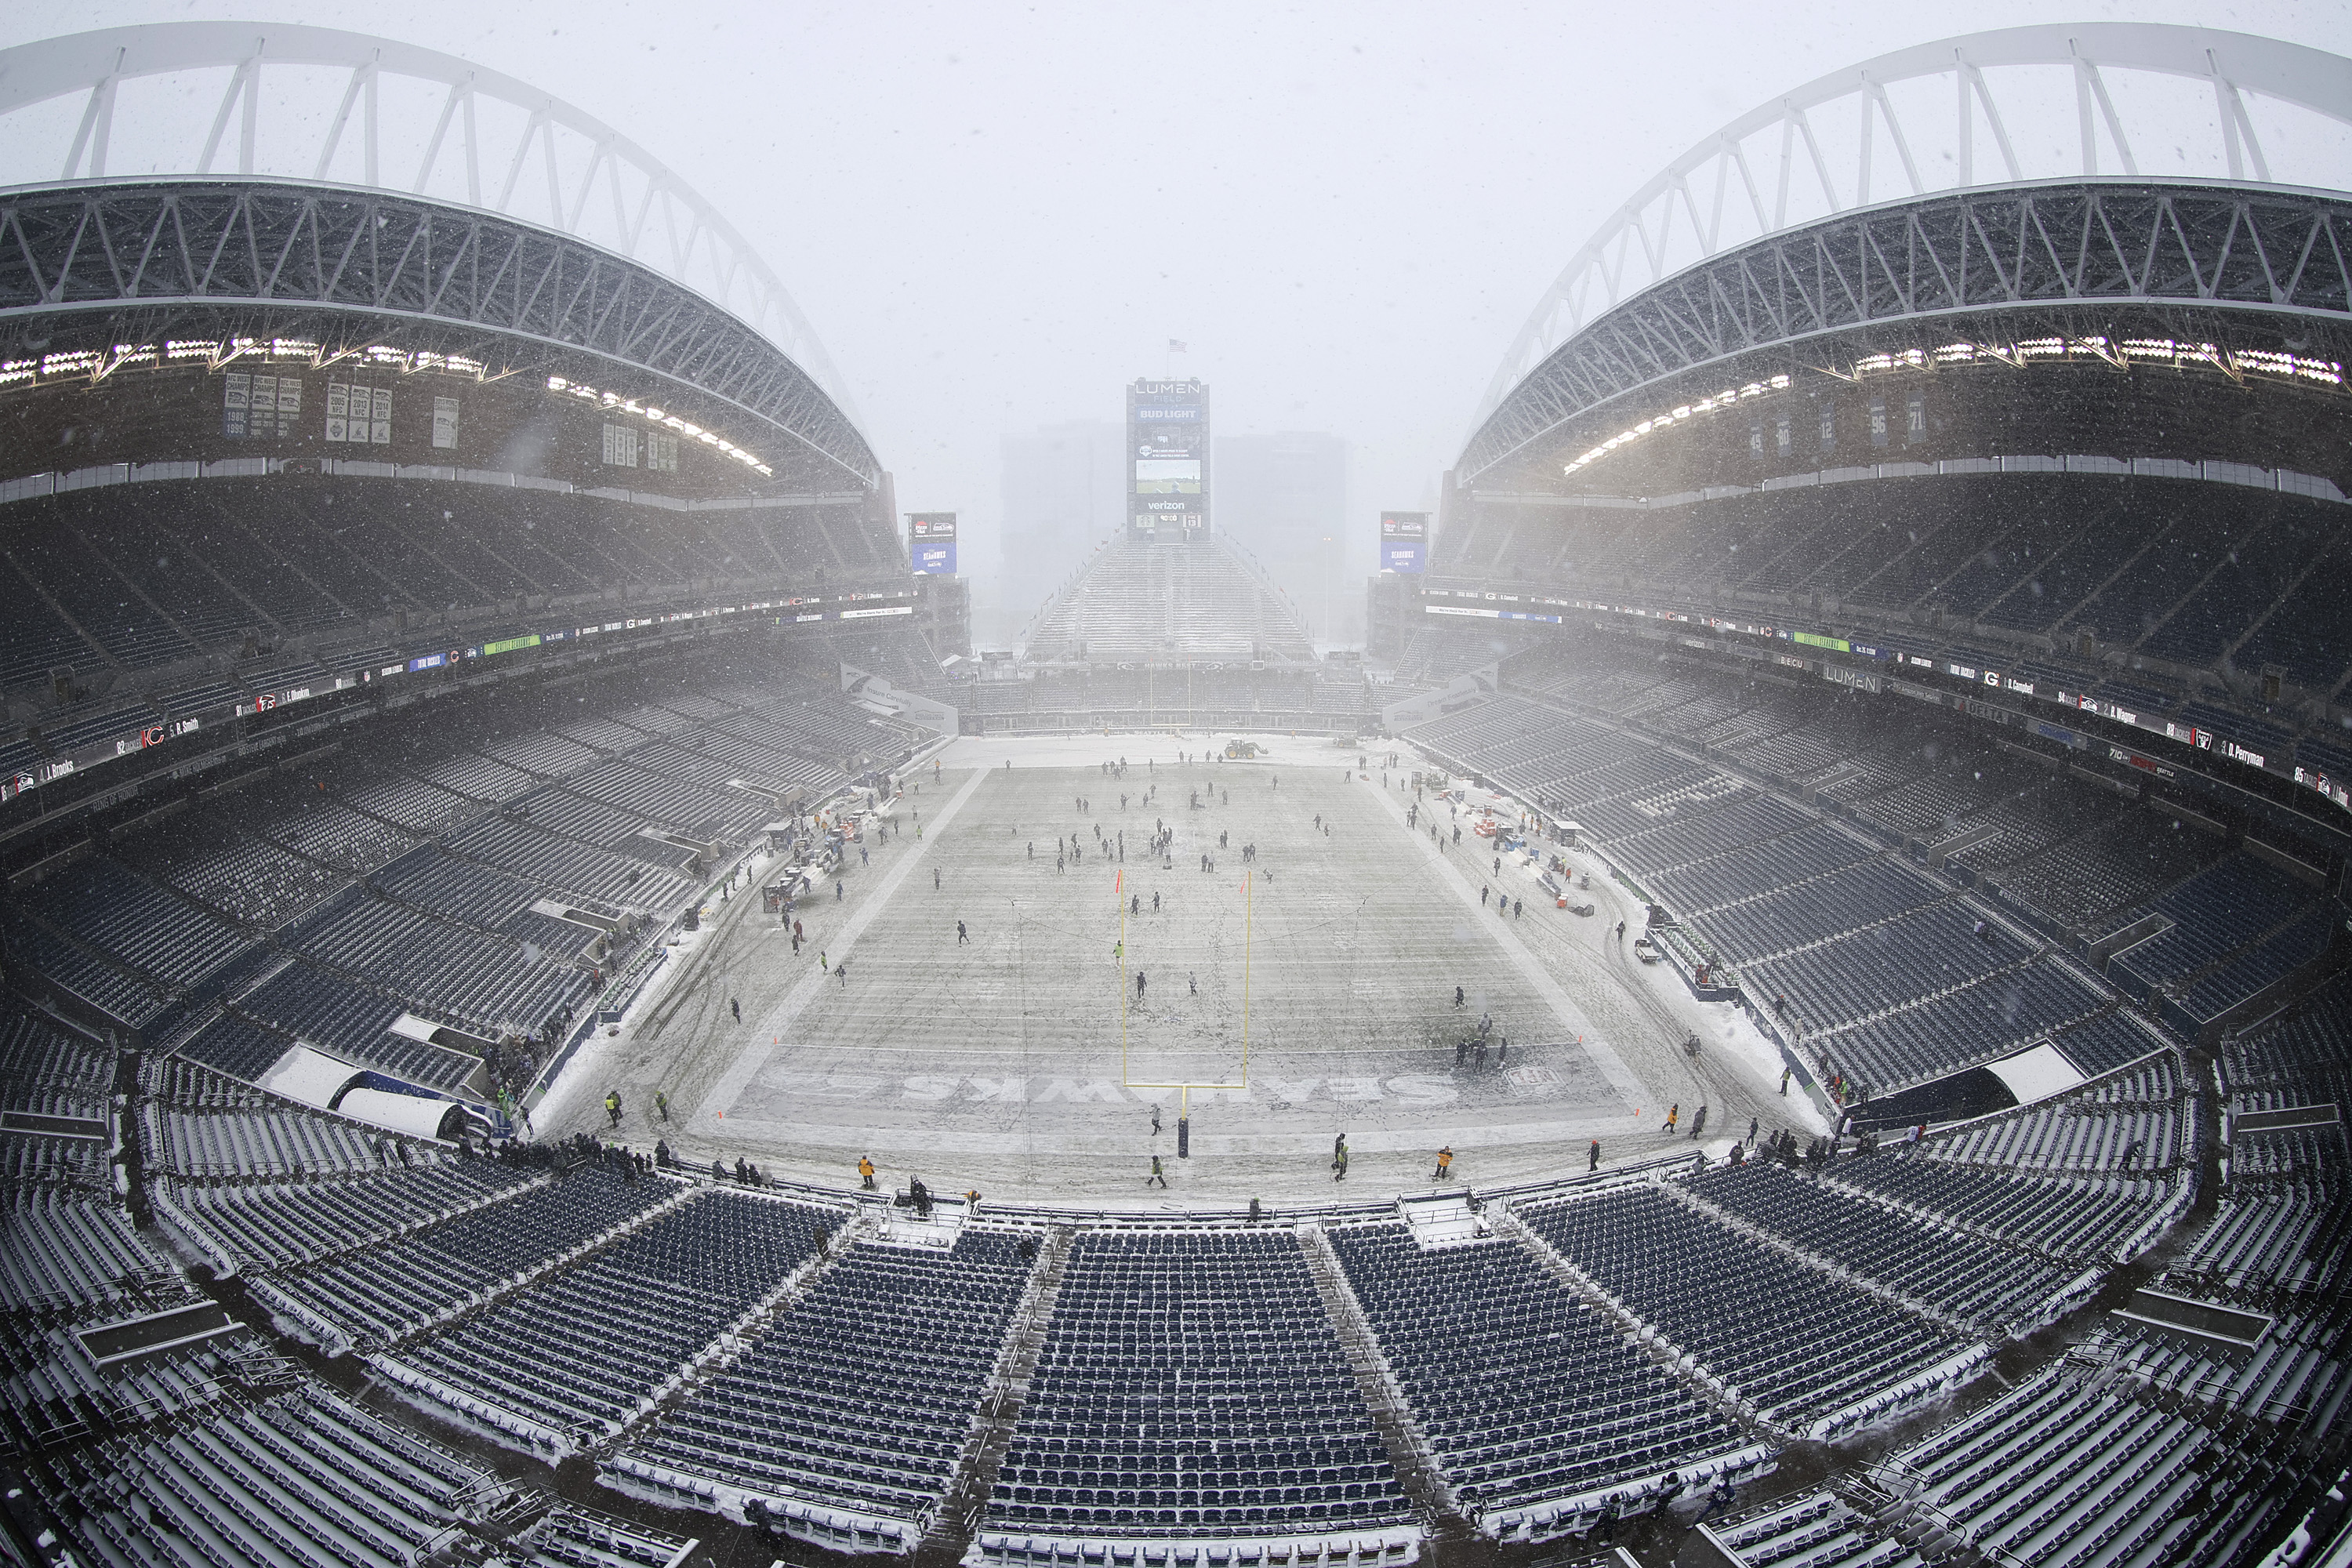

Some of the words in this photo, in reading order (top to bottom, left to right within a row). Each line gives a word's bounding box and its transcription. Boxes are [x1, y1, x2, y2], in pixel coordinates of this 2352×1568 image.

[1136, 384, 1199, 393] LUMEN
[331, 397, 345, 406] 2005
[353, 400, 367, 408] 2013
[376, 402, 388, 410] 2014
[228, 412, 244, 422] 1988
[1872, 415, 1885, 434] 96
[1910, 412, 1923, 430] 71
[227, 424, 244, 434] 1999
[1822, 422, 1832, 439] 12
[1751, 434, 1761, 449] 45
[1779, 429, 1789, 445] 80
[1148, 501, 1184, 509] verizon
[1686, 639, 1705, 649] verizon
[450, 650, 459, 662] C
[1781, 656, 1803, 668] BECU
[1826, 667, 1876, 691] LUMEN
[1950, 664, 1960, 676] TOTAL
[1960, 667, 1975, 679] TACKLES
[1985, 672, 1998, 686] G
[335, 678, 342, 689] 80
[2008, 678, 2013, 689] D.
[2013, 680, 2033, 694] Campbell
[867, 687, 885, 697] Insure
[886, 693, 912, 707] Carefully
[1428, 698, 1447, 707] Dream
[1448, 687, 1476, 699] Fearlessly
[2058, 691, 2065, 703] 94
[236, 705, 242, 717] 81
[1971, 703, 2003, 724] DELTA
[2110, 705, 2115, 718] B.
[2116, 707, 2136, 724] Wagner
[176, 723, 183, 735] R.
[183, 717, 199, 733] Smith
[2167, 722, 2175, 736] 88
[2175, 727, 2190, 742] TACKLES
[117, 740, 125, 754] 82
[125, 738, 142, 752] TACKLES
[238, 747, 246, 756] 80
[2221, 740, 2227, 755] 3.
[2228, 743, 2234, 757] D.
[2235, 745, 2265, 767] Perryman
[2109, 748, 2123, 760] 710
[47, 766, 52, 780] J.
[52, 760, 74, 778] Brooks
[2157, 767, 2174, 777] SEATTLE
[2294, 766, 2304, 783] 85
[93, 798, 109, 812] RING
[110, 795, 117, 805] OF
[119, 785, 138, 801] HONOR
[1860, 813, 1874, 824] DELTA
[451, 824, 466, 835] DELTA
[2004, 893, 2021, 907] DELTA
[299, 909, 317, 924] DELTA
[902, 1073, 1458, 1105] SEAHAWKS
